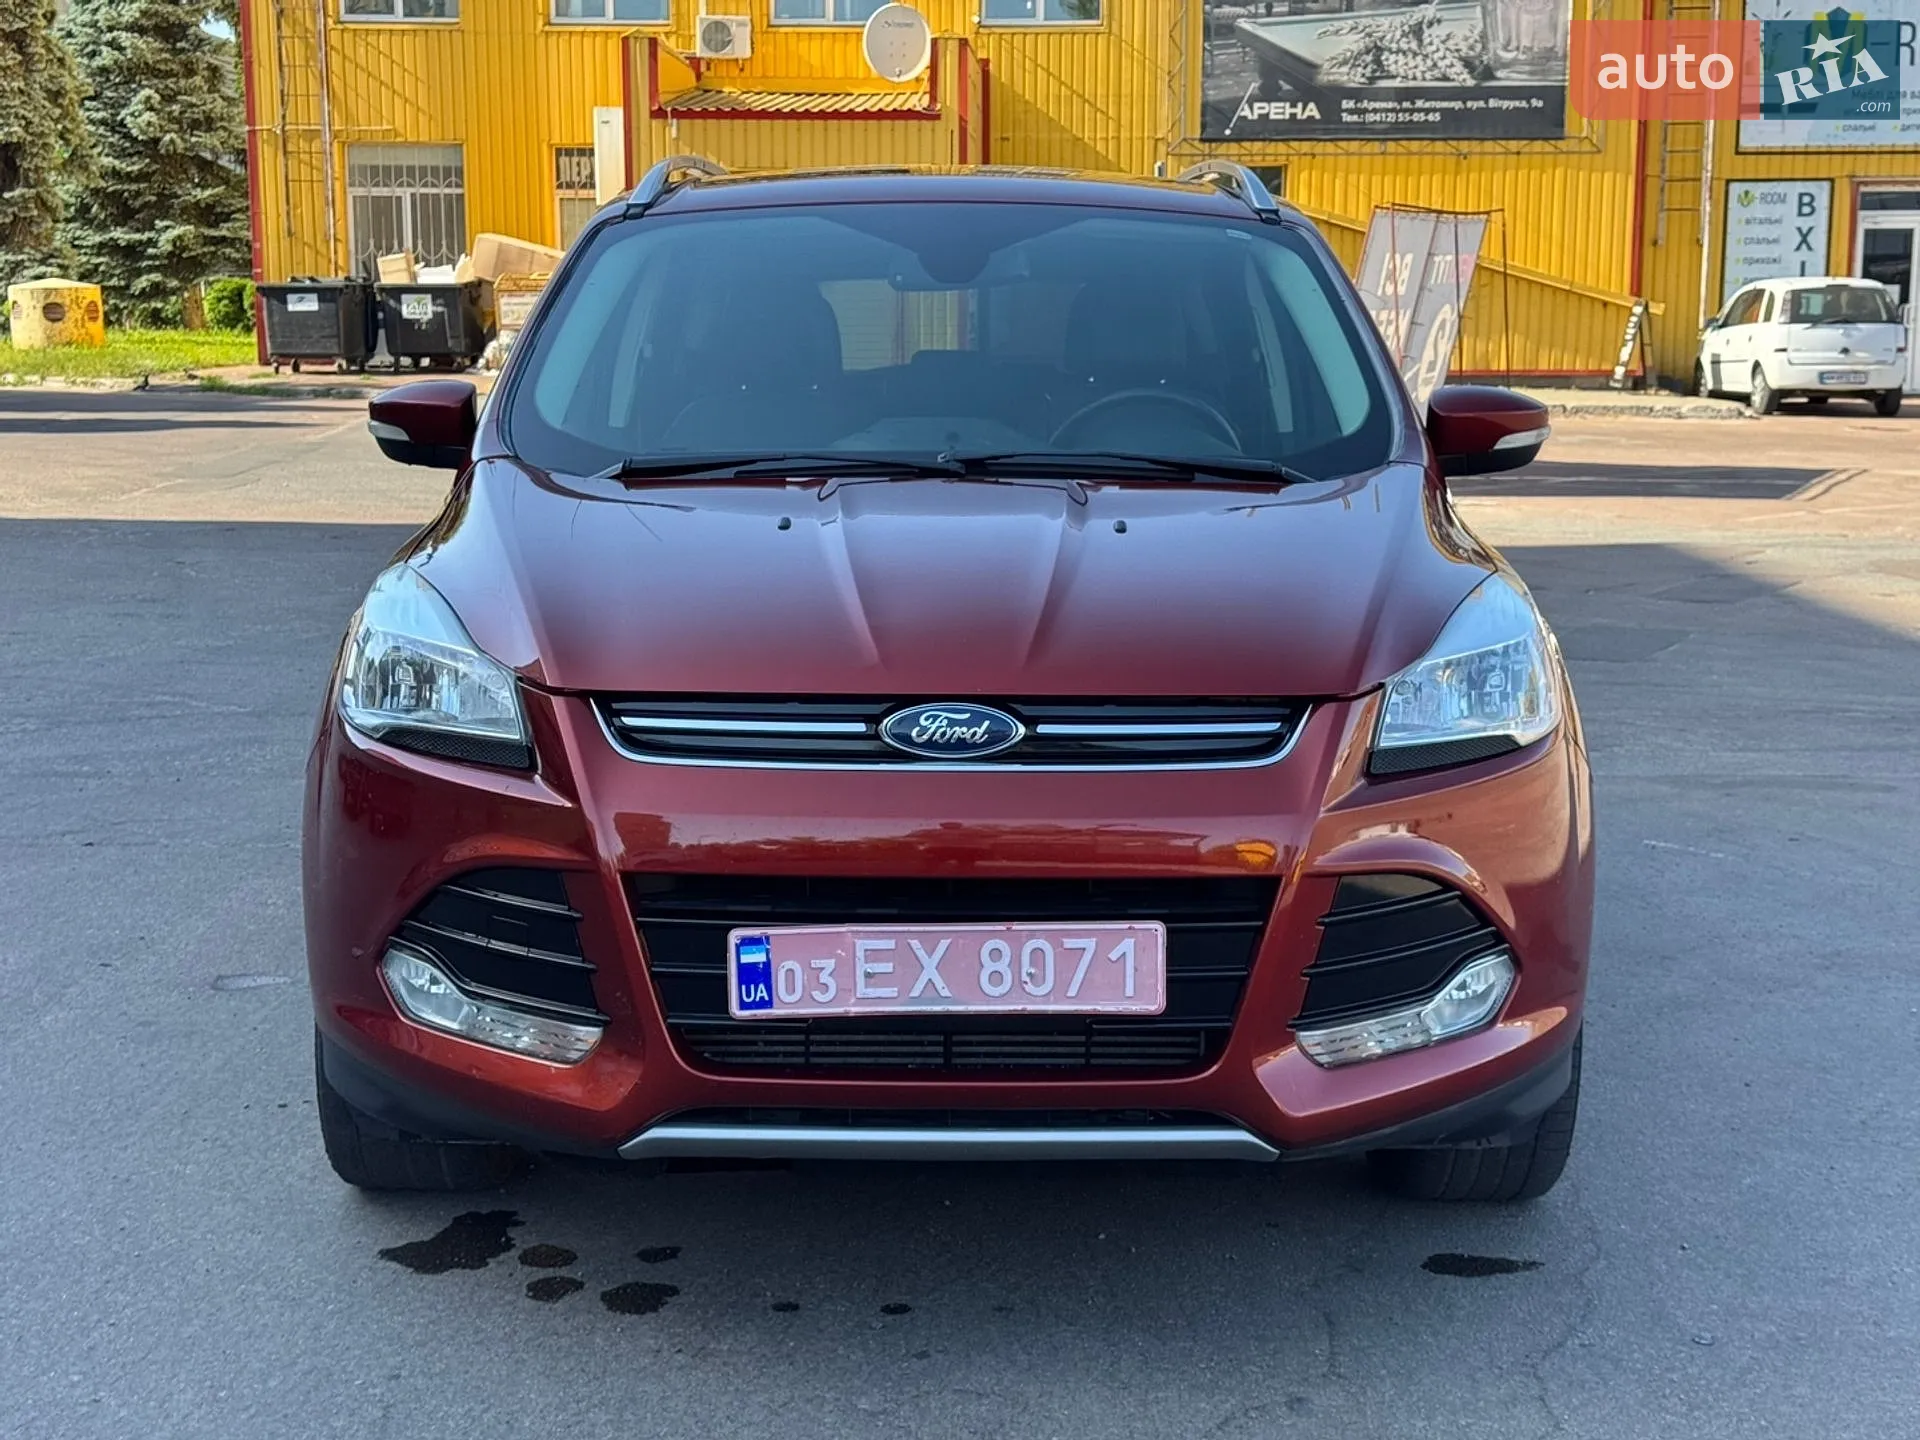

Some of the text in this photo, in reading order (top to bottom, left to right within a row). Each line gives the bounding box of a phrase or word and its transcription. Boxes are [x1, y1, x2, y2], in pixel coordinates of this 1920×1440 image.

[1239, 102, 1321, 119] АРЕНА
[911, 711, 990, 743] Ford
[777, 938, 1135, 1003] 03 EX 8071
[742, 985, 769, 1003] UA
